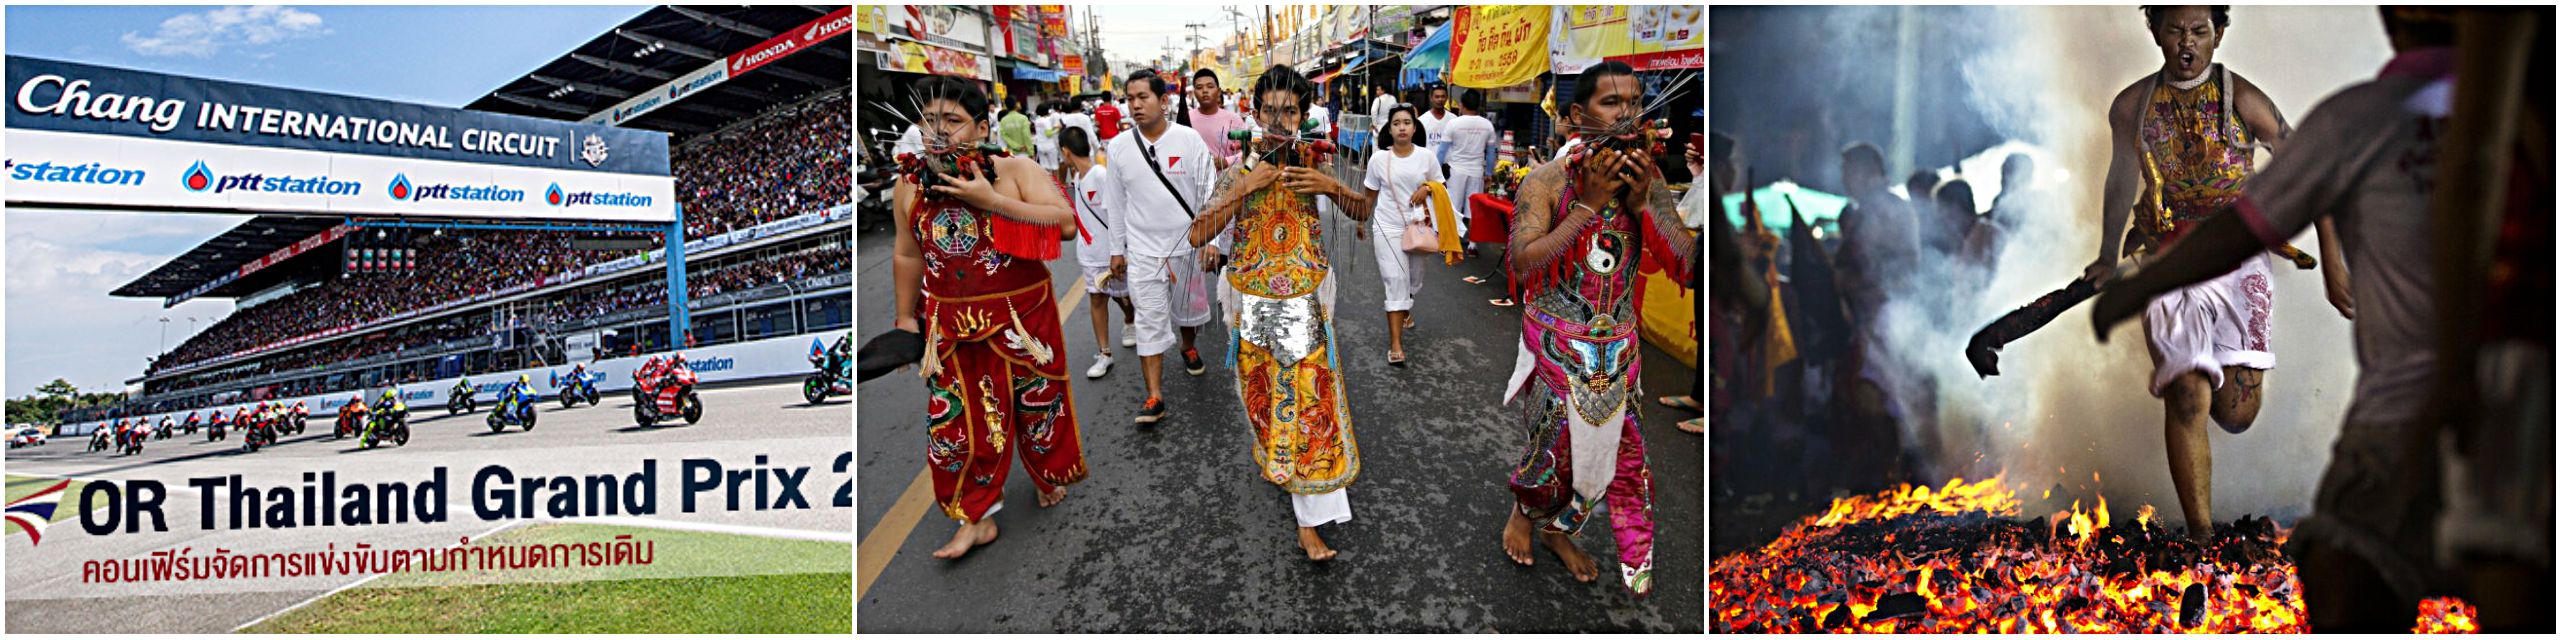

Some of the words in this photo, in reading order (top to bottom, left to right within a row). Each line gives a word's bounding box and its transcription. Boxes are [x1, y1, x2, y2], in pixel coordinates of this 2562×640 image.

[745, 39, 795, 66] HONDA
[17, 75, 185, 131] Chang
[197, 102, 452, 149] INTERNATIONAL
[461, 129, 559, 158] CIRCUIT
